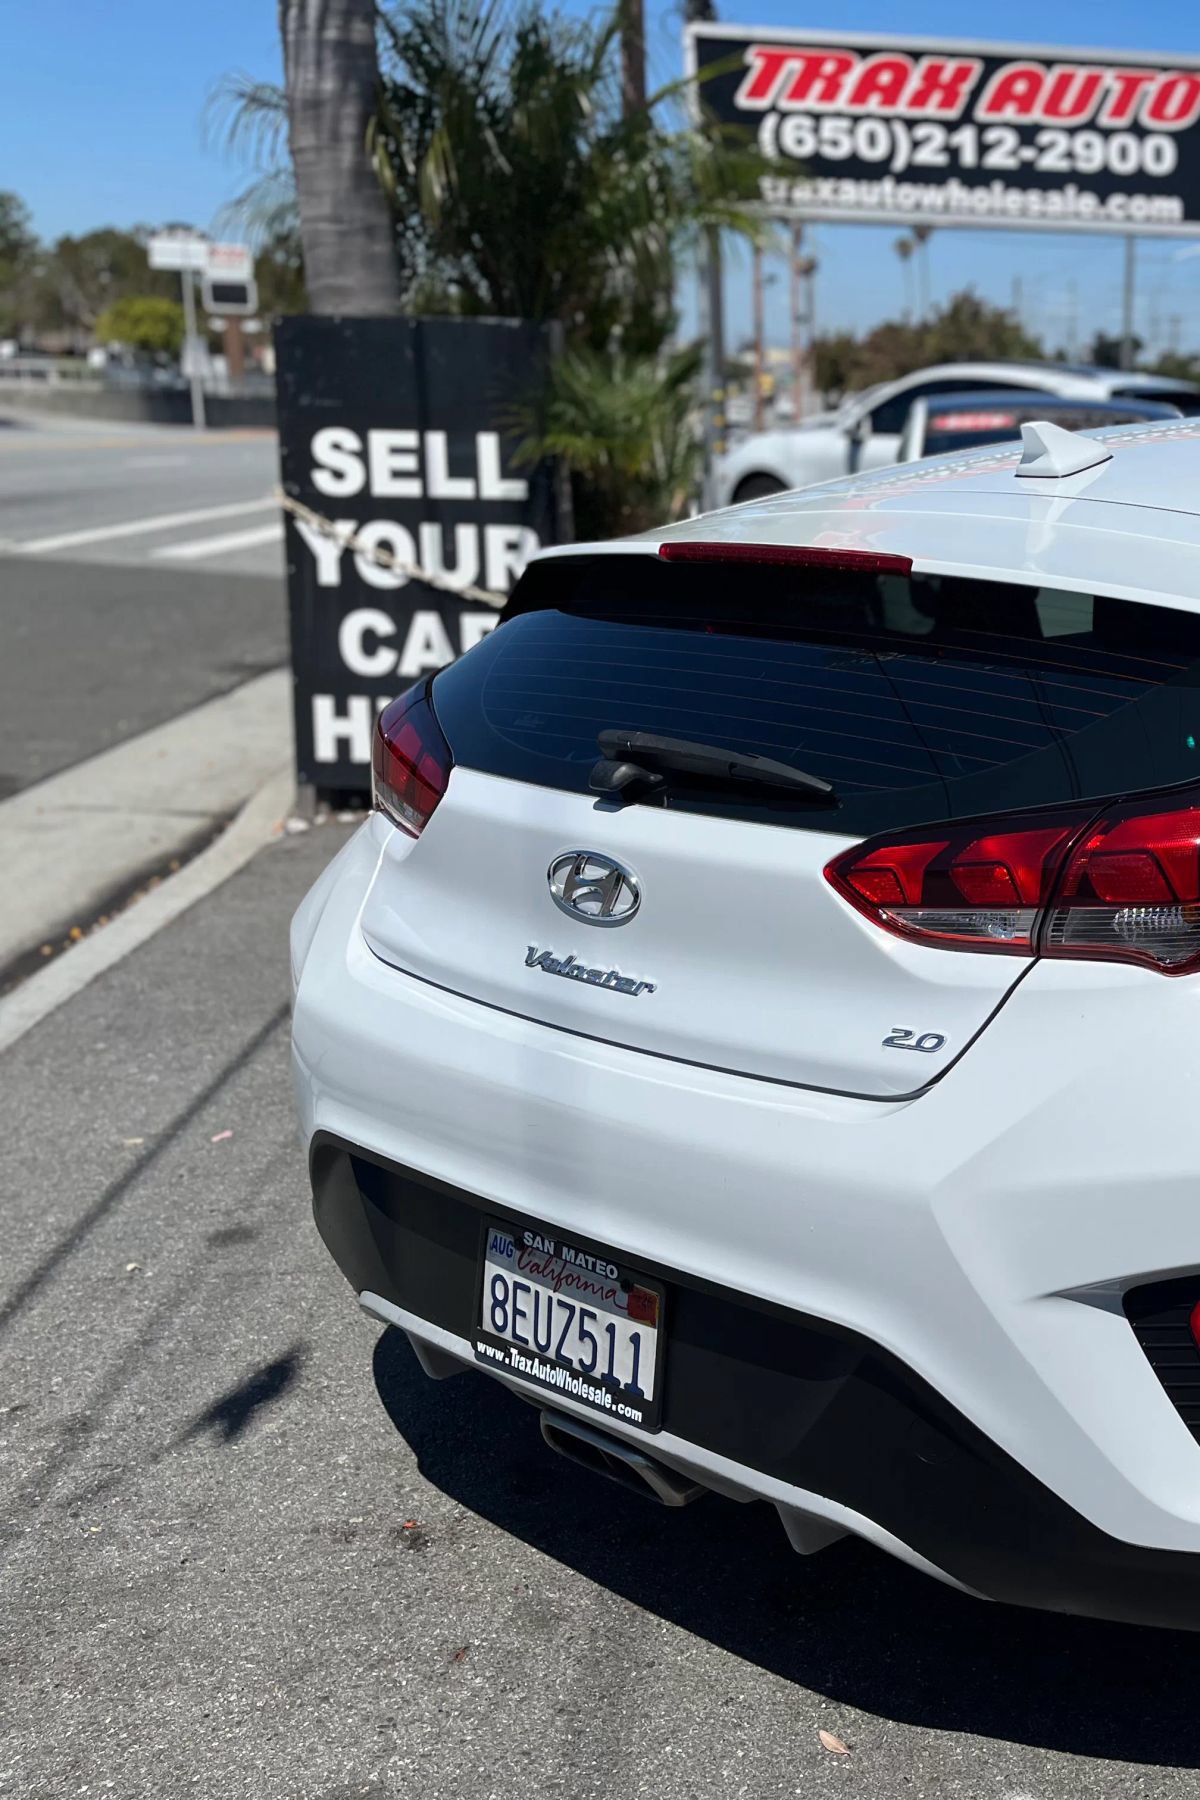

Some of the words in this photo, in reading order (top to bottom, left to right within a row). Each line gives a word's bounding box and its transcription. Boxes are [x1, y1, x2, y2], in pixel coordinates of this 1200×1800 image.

[735, 45, 983, 120] TRAX
[758, 114, 1178, 175] (650)212-2900
[757, 174, 1184, 222] traxautowholesale.com
[310, 426, 528, 500] SELL
[294, 518, 541, 592] YOUR
[525, 945, 657, 997] Veloster
[489, 1233, 515, 1259] AUG
[522, 1230, 555, 1256] SAN
[561, 1245, 619, 1281] MATEO
[516, 1247, 629, 1311] California
[490, 1272, 645, 1398] 8EUZ511
[476, 1341, 643, 1424] www.TraxAutoWholesale.com
